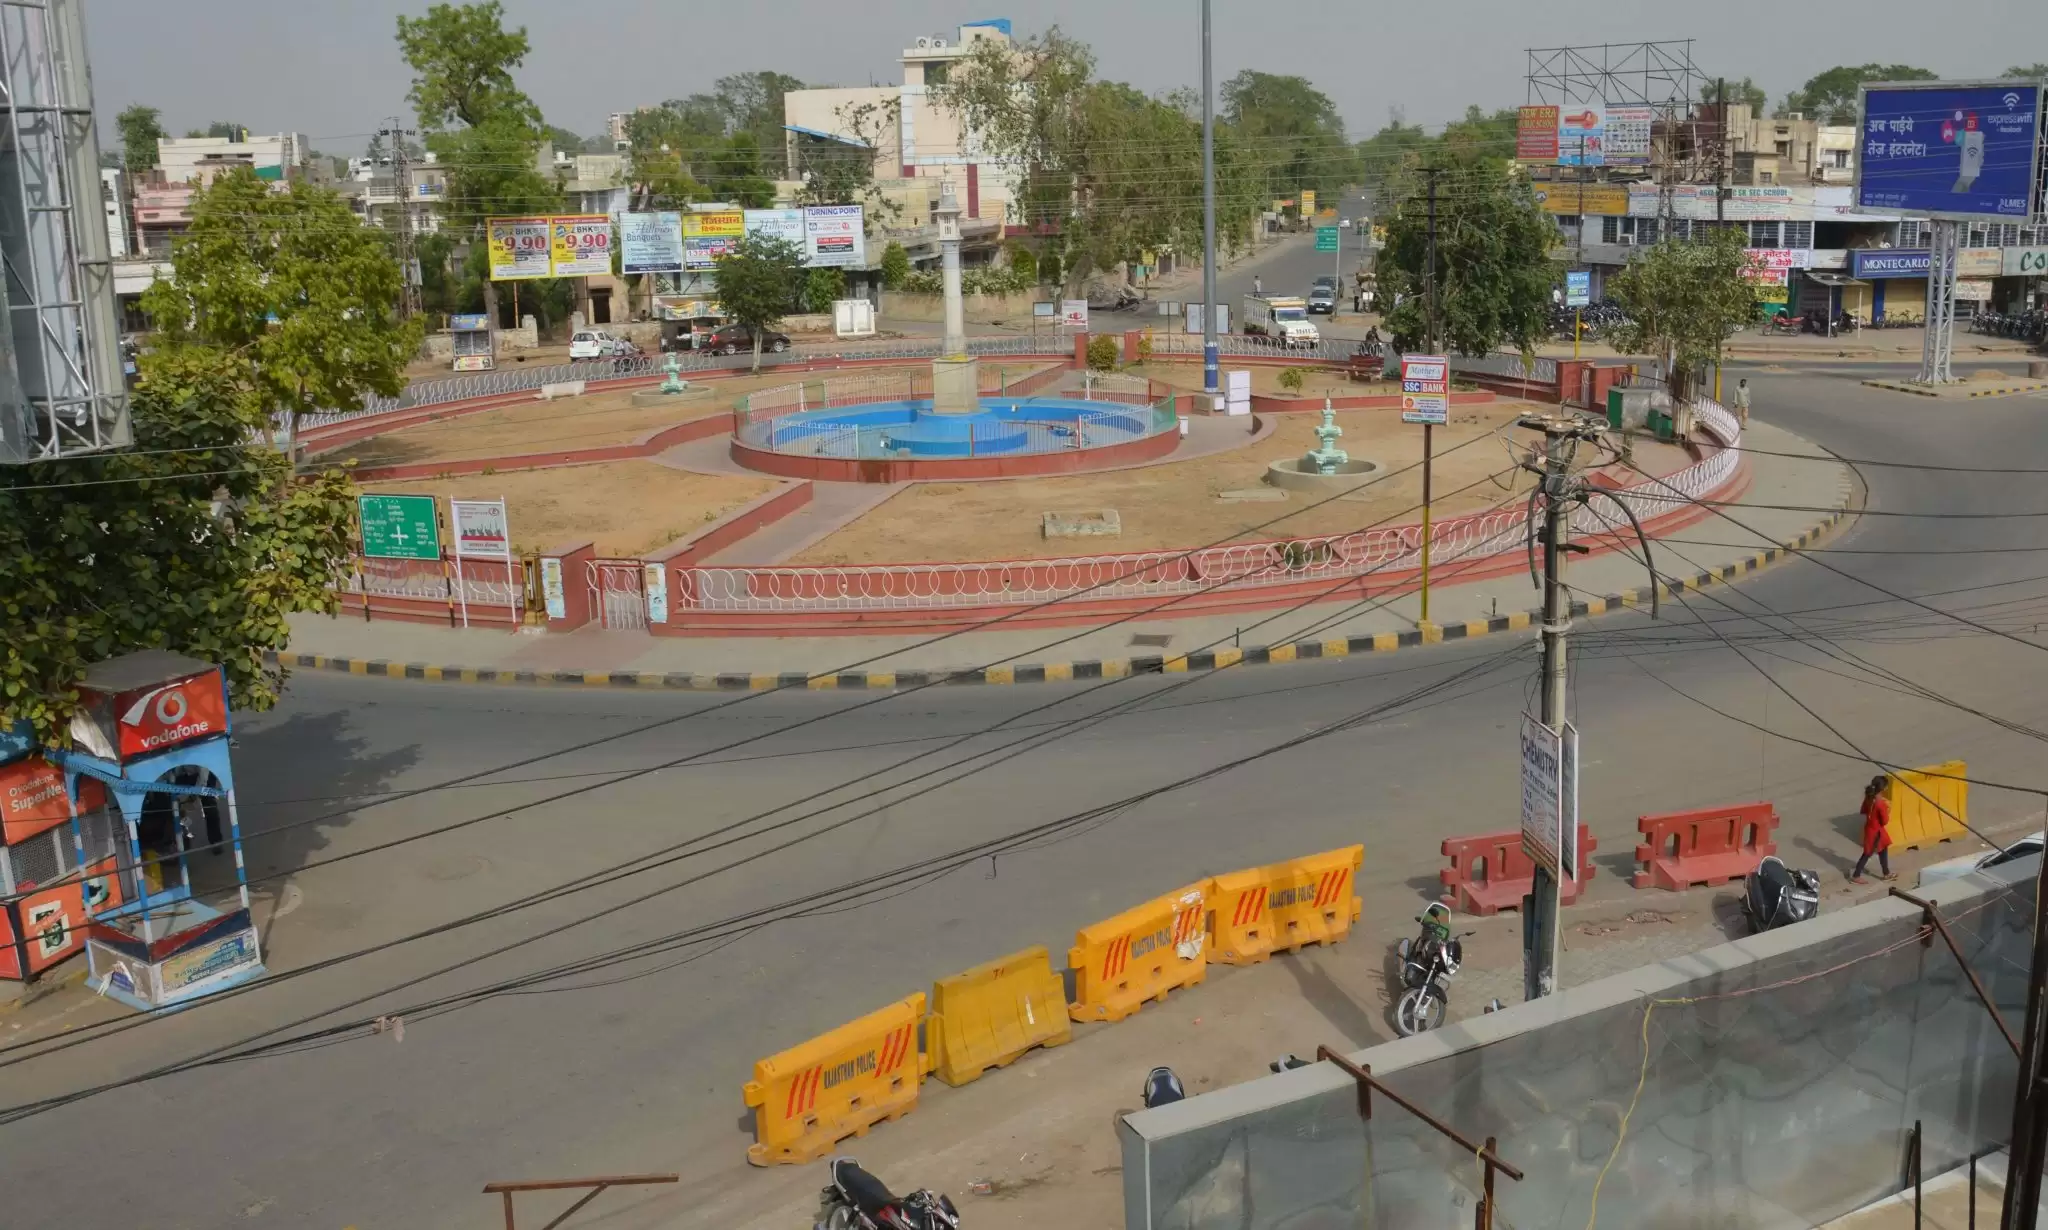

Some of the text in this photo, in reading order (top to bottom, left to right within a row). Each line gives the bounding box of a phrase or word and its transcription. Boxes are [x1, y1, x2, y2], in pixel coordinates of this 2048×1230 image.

[1540, 107, 1556, 118] ERA
[1868, 119, 1886, 133] अब
[1763, 188, 1788, 197] SCHOOL
[808, 206, 860, 216] TURNING POINT
[515, 227, 532, 235] BHK
[576, 225, 593, 233] BHK
[505, 235, 546, 250] 9.90
[565, 233, 608, 249] 9.90
[626, 233, 661, 243] Banquets
[1404, 382, 1445, 393] SSC BANK
[140, 720, 209, 748] vodafone
[1522, 737, 1558, 782] CHEMISTRY
[17, 773, 55, 794] vodafone
[1268, 882, 1317, 910] RAJASTHAN POLICE
[1131, 925, 1172, 960] RAJASTHAN POLICE
[824, 1049, 876, 1090] RAJASTHAN POLICE
